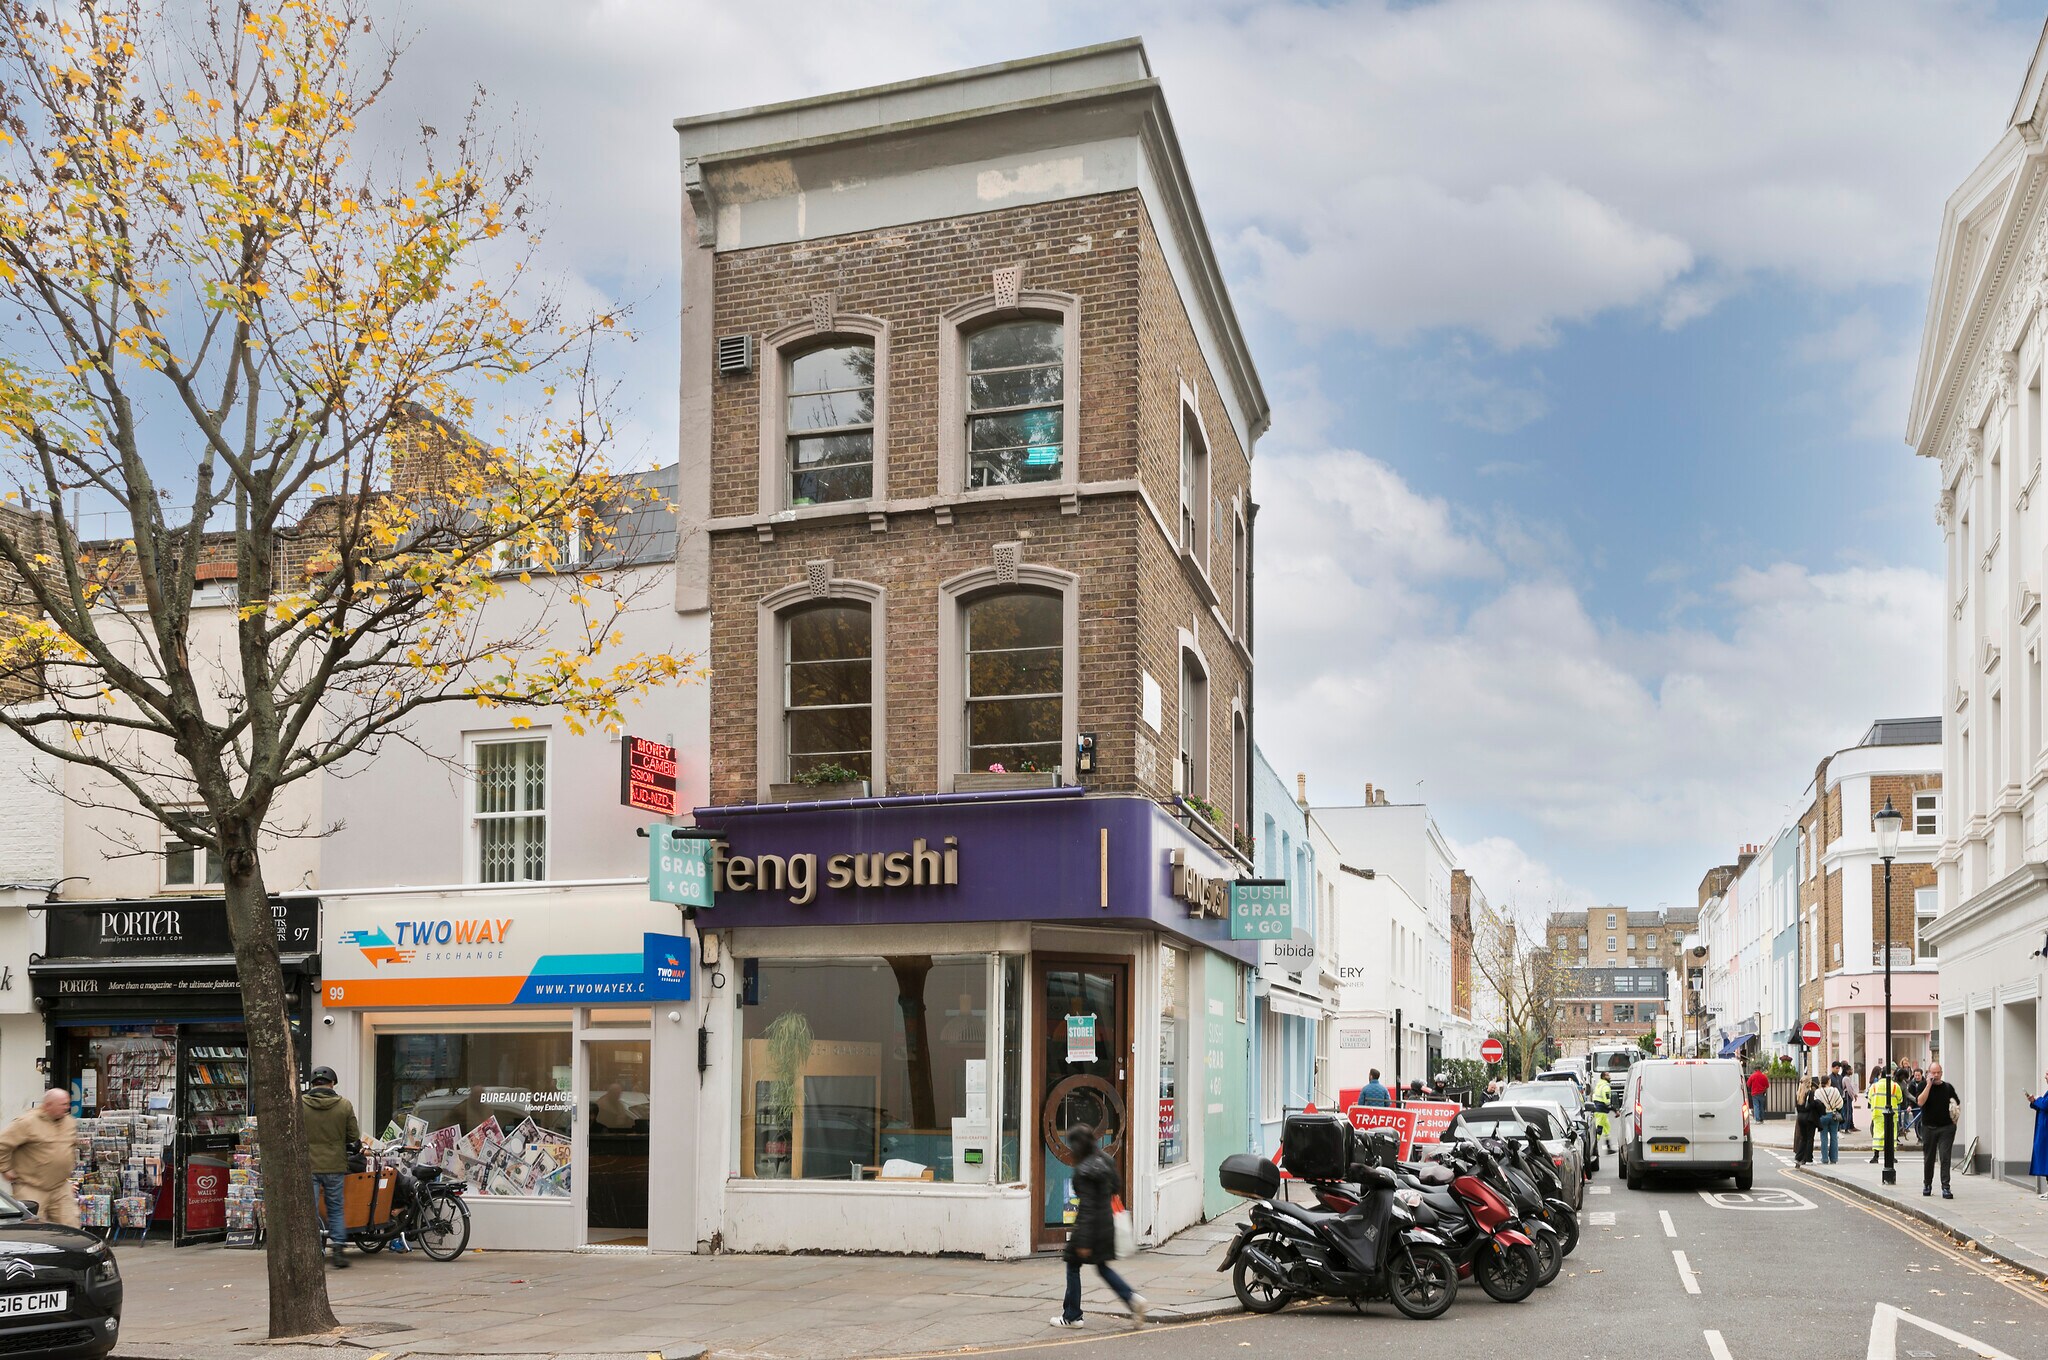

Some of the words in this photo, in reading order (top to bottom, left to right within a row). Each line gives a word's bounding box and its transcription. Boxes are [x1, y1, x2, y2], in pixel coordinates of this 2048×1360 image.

[638, 740, 671, 759] MONEY
[661, 833, 705, 856] SUSHI
[661, 856, 706, 877] GRAB
[713, 841, 816, 904] feng
[826, 835, 958, 889] sushi
[1238, 886, 1289, 900] SUSHI
[1238, 904, 1290, 916] GRAB
[294, 928, 310, 941] 97
[395, 919, 513, 945] TWOWAY
[426, 951, 503, 961] EXCHANGE
[1274, 944, 1314, 957] bibida
[108, 982, 124, 990] More
[125, 981, 140, 990] than
[145, 981, 172, 991] magazine
[178, 980, 188, 989] the
[189, 980, 214, 989] ultimate
[213, 978, 235, 990] fashion
[536, 983, 645, 995] WWW.TWOWAYEX.C
[330, 986, 344, 1000] 99
[1208, 1050, 1224, 1069] GRAB
[480, 1092, 517, 1103] BUREAU
[519, 1092, 531, 1102] DE
[533, 1091, 572, 1102] CHANGE
[525, 1104, 544, 1112] Money
[545, 1103, 572, 1113] Exchange
[1434, 1109, 1455, 1117] STOP
[1355, 1114, 1407, 1129] TRAFFIC
[28, 1294, 59, 1310] CHN
